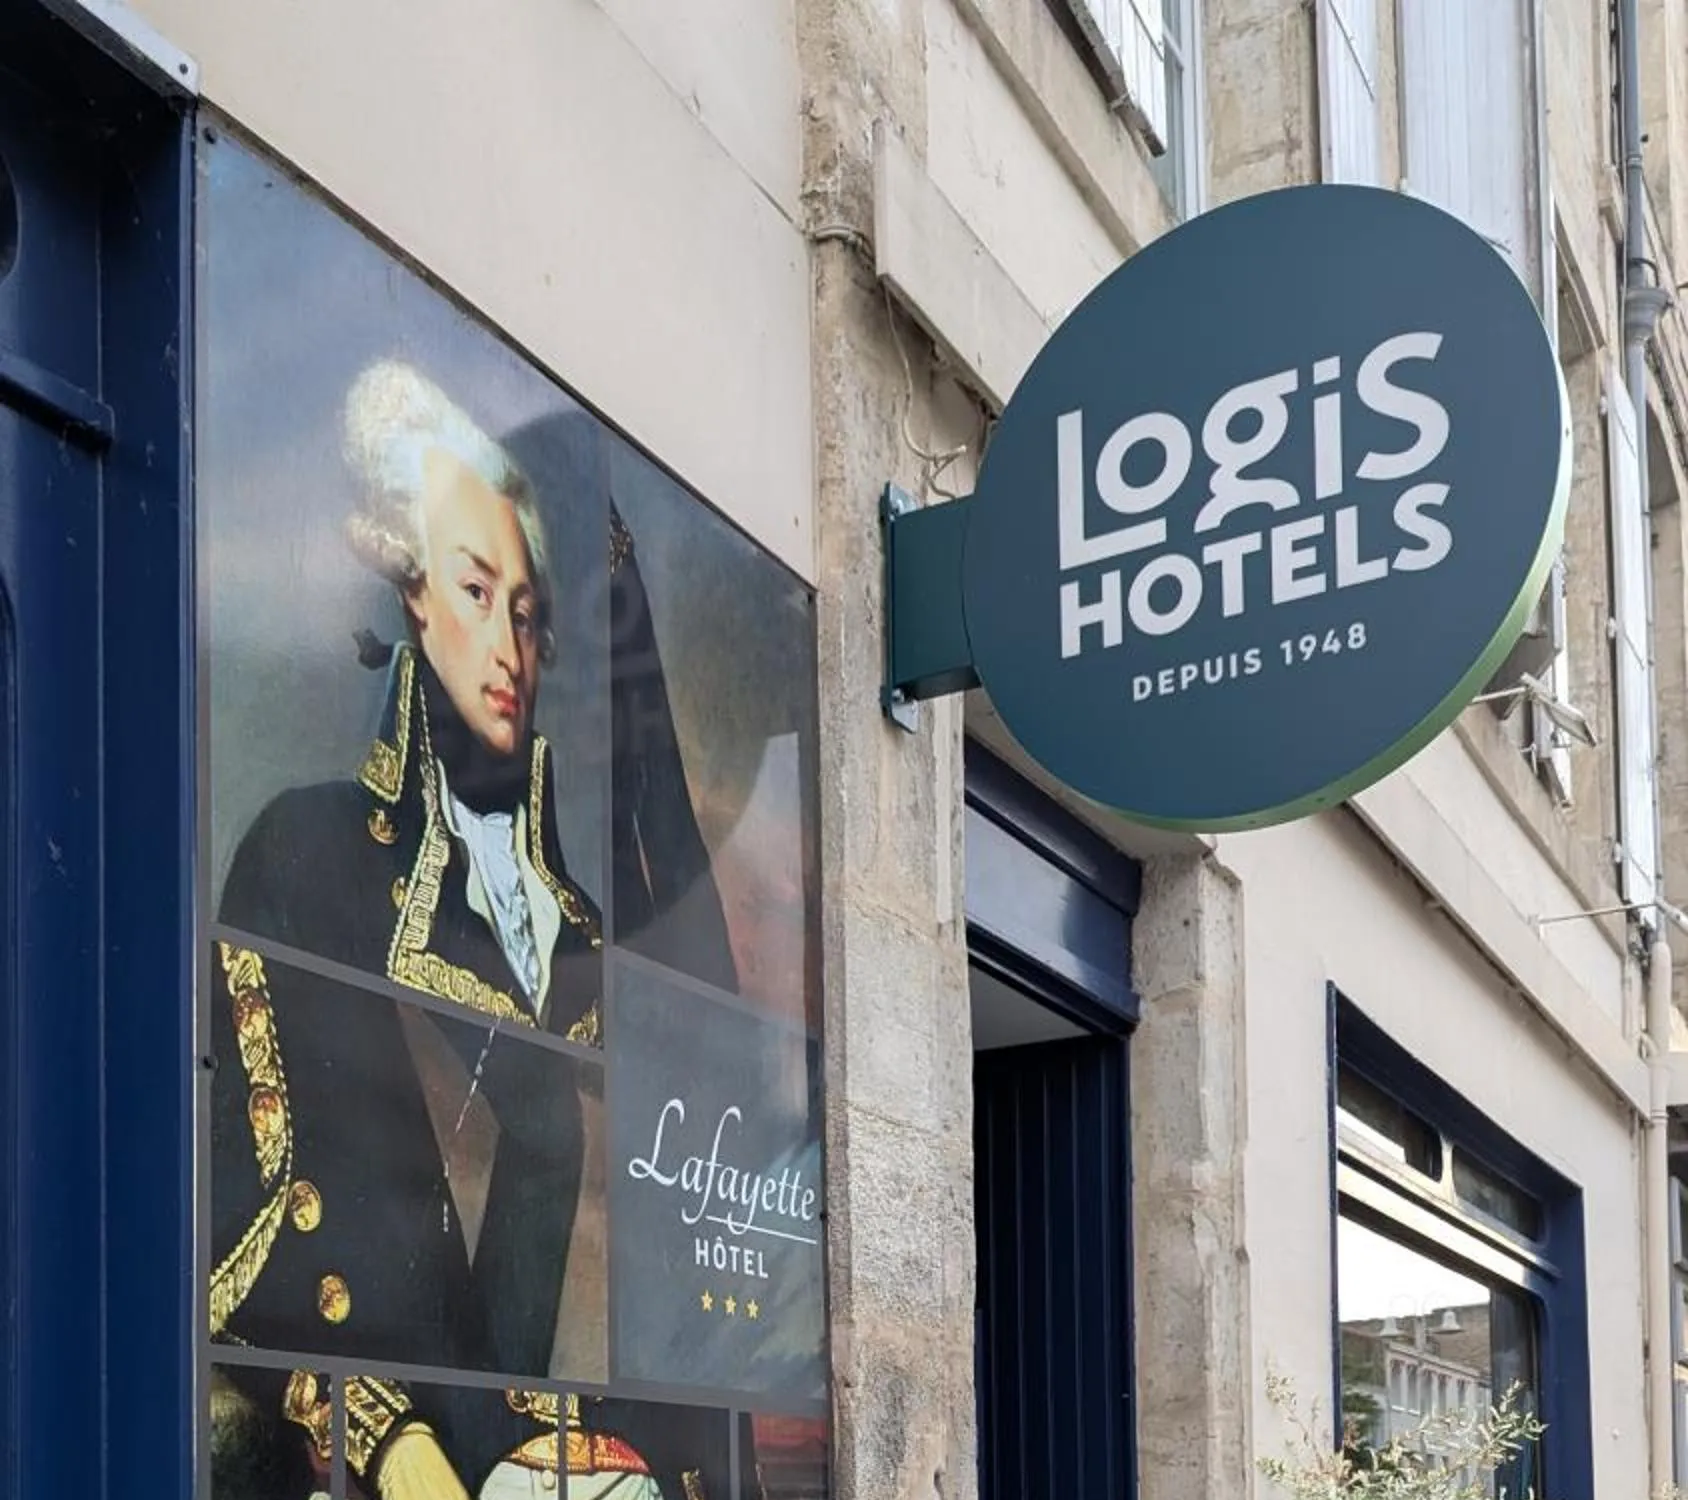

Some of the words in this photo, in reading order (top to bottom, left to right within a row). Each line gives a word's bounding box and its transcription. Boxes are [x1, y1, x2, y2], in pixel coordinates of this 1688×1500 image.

[1061, 483, 1453, 659] HOTELS
[1133, 648, 1262, 701] DEPUIS
[1280, 622, 1367, 665] 1948
[628, 1098, 816, 1236] Lafayette
[695, 1236, 769, 1279] HÔTEL
